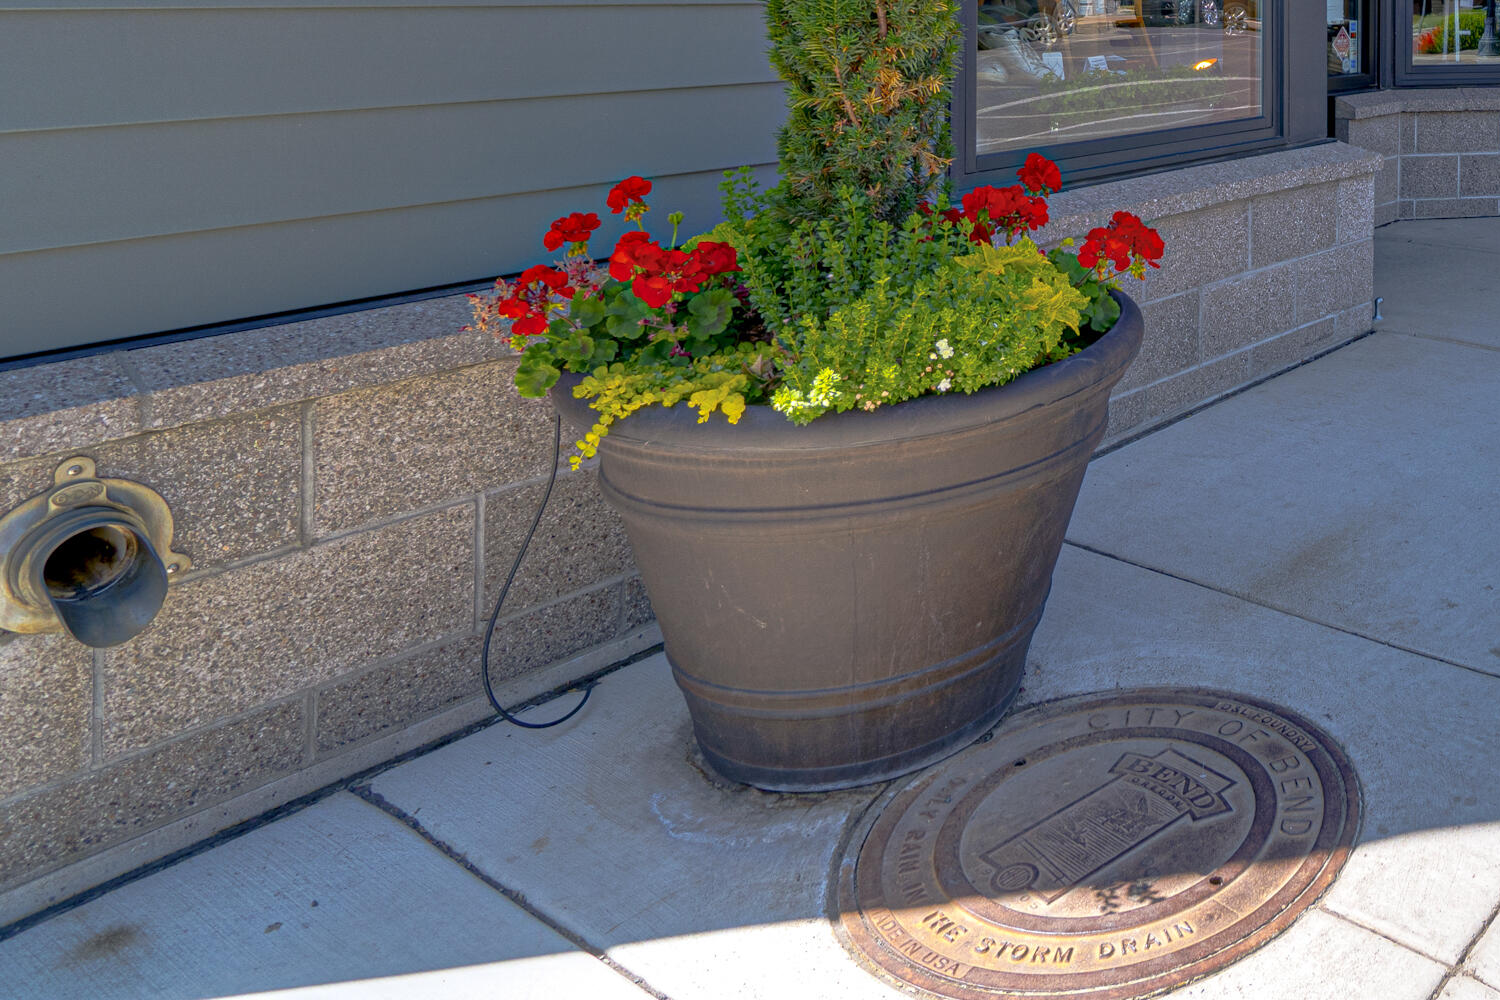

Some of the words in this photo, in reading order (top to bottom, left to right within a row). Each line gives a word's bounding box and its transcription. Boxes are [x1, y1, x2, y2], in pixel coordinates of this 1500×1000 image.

[1087, 708, 1196, 729] CITY
[1217, 719, 1270, 744] OF
[1268, 755, 1315, 836] BEND
[1125, 756, 1216, 810] BEND
[899, 935, 920, 957] IN
[922, 949, 961, 976] USA
[922, 910, 968, 943] THE
[974, 936, 1074, 963] STORM
[1098, 920, 1195, 960] DRAIN
